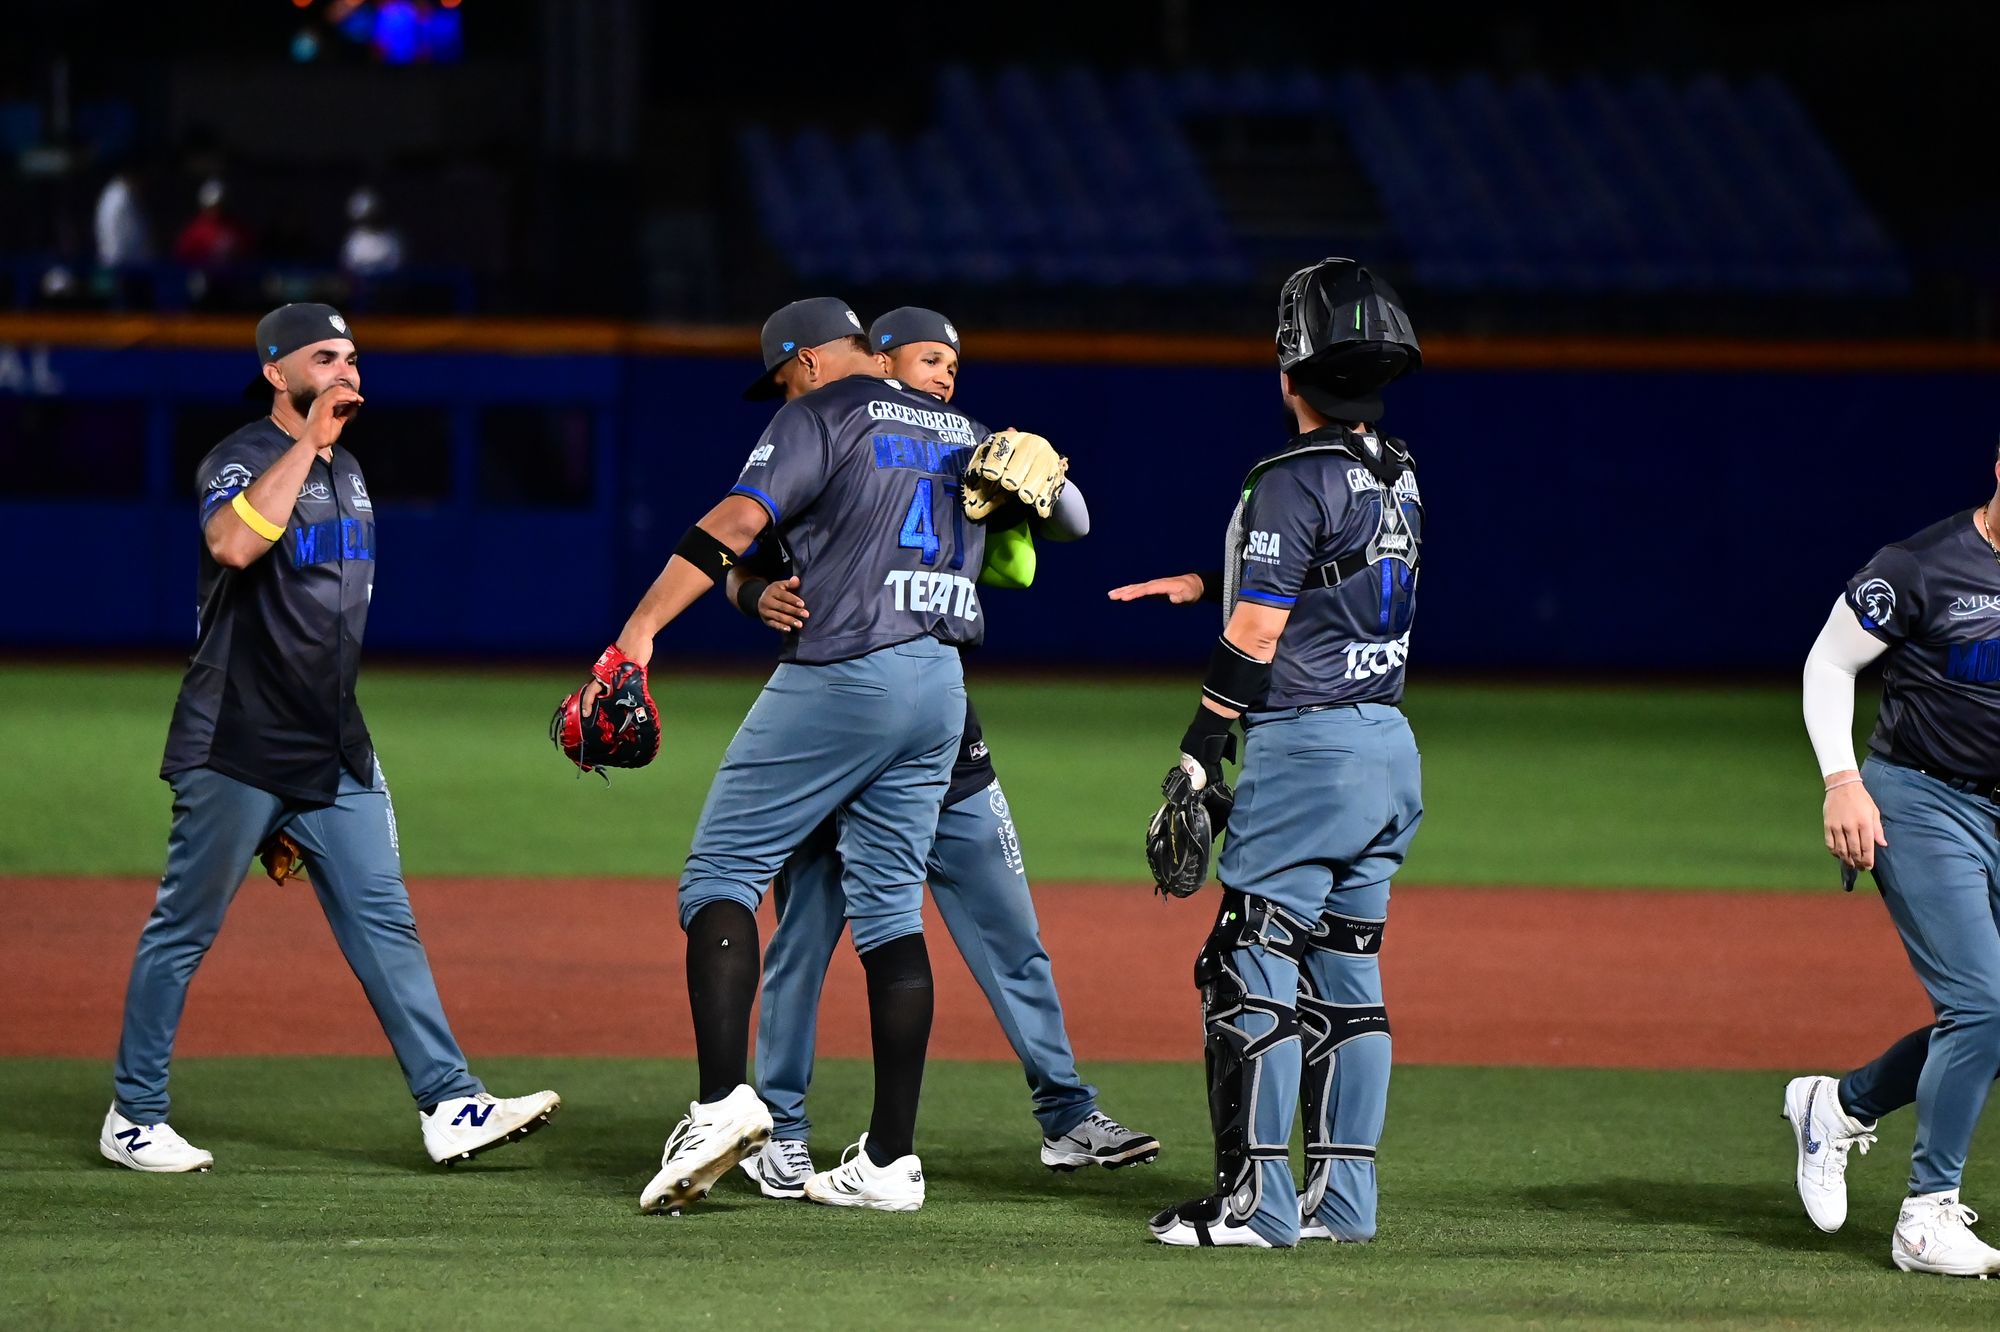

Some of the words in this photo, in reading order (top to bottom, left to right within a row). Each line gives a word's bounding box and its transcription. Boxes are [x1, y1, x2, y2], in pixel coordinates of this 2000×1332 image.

[867, 400, 974, 436] GREENBRIER
[937, 430, 978, 447] GIMSA
[997, 826, 1013, 869] KICKAPOO
